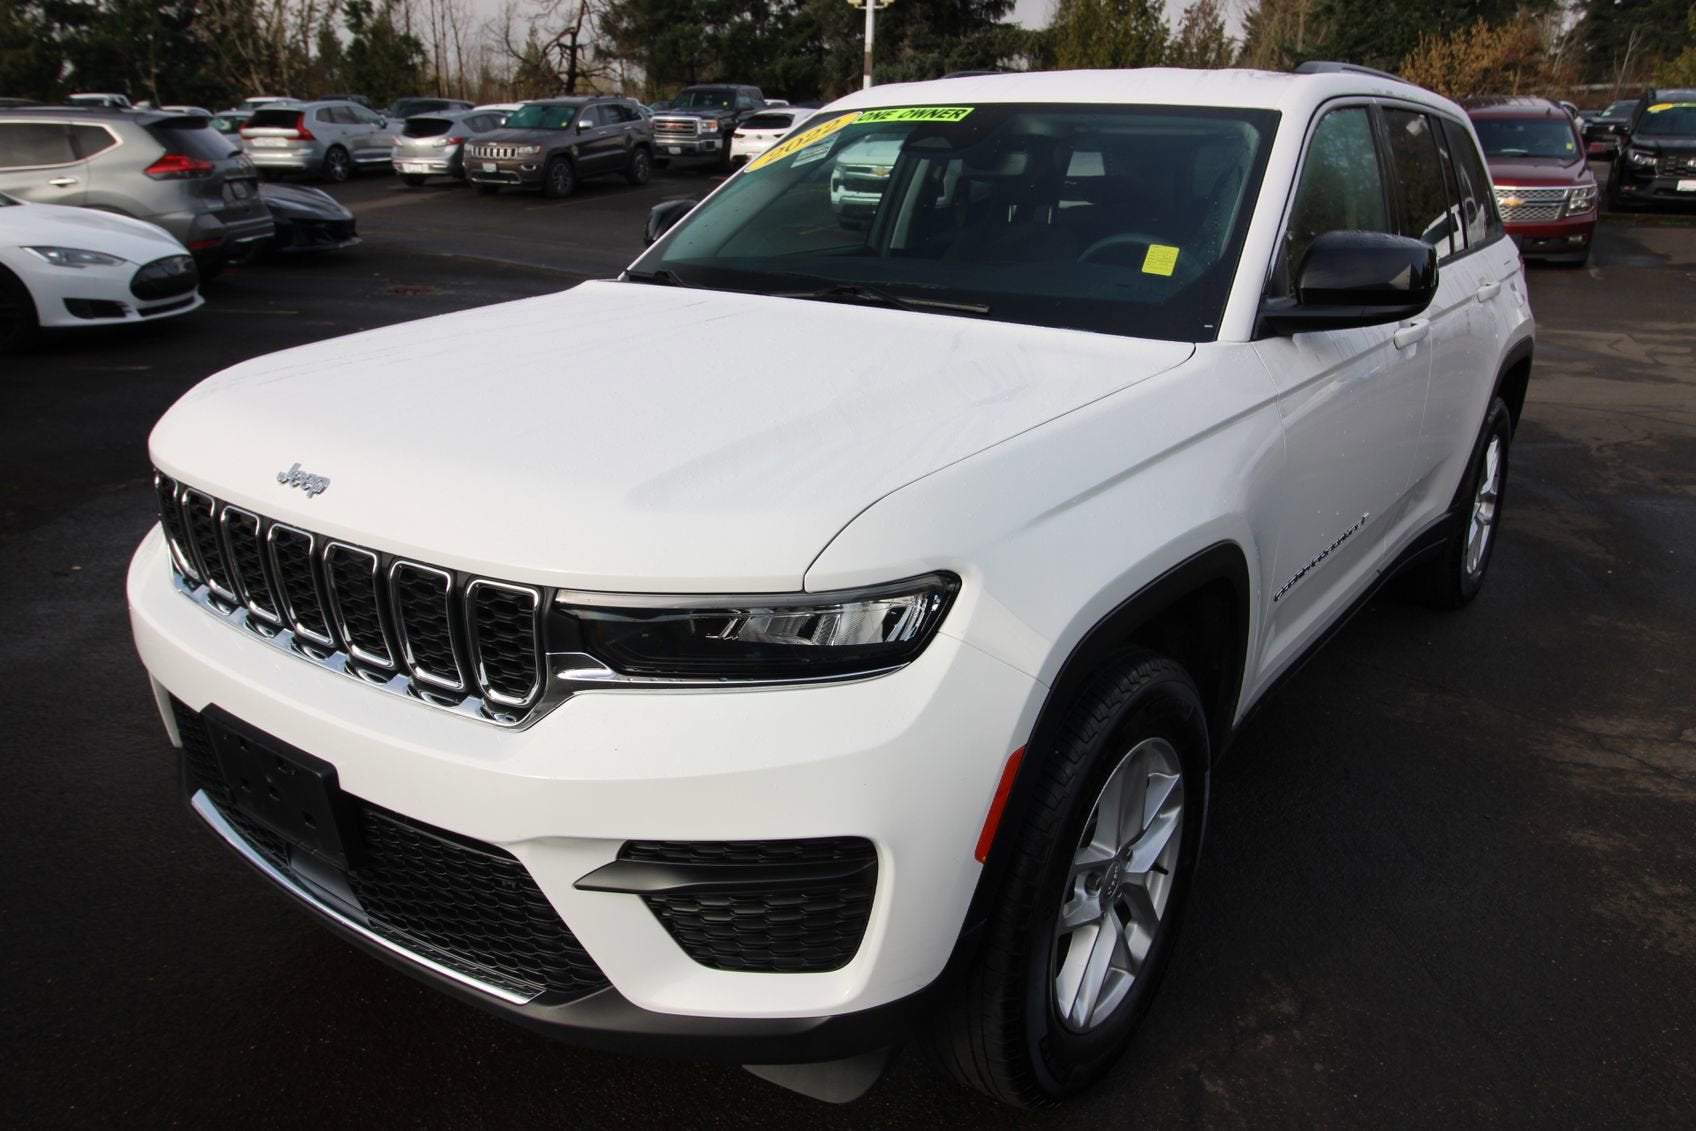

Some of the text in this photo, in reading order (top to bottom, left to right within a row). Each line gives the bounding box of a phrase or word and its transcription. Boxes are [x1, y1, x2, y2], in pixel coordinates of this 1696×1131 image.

[857, 108, 968, 121] ONE OWNER
[766, 119, 841, 163] 2022
[277, 463, 331, 499] Jeep
